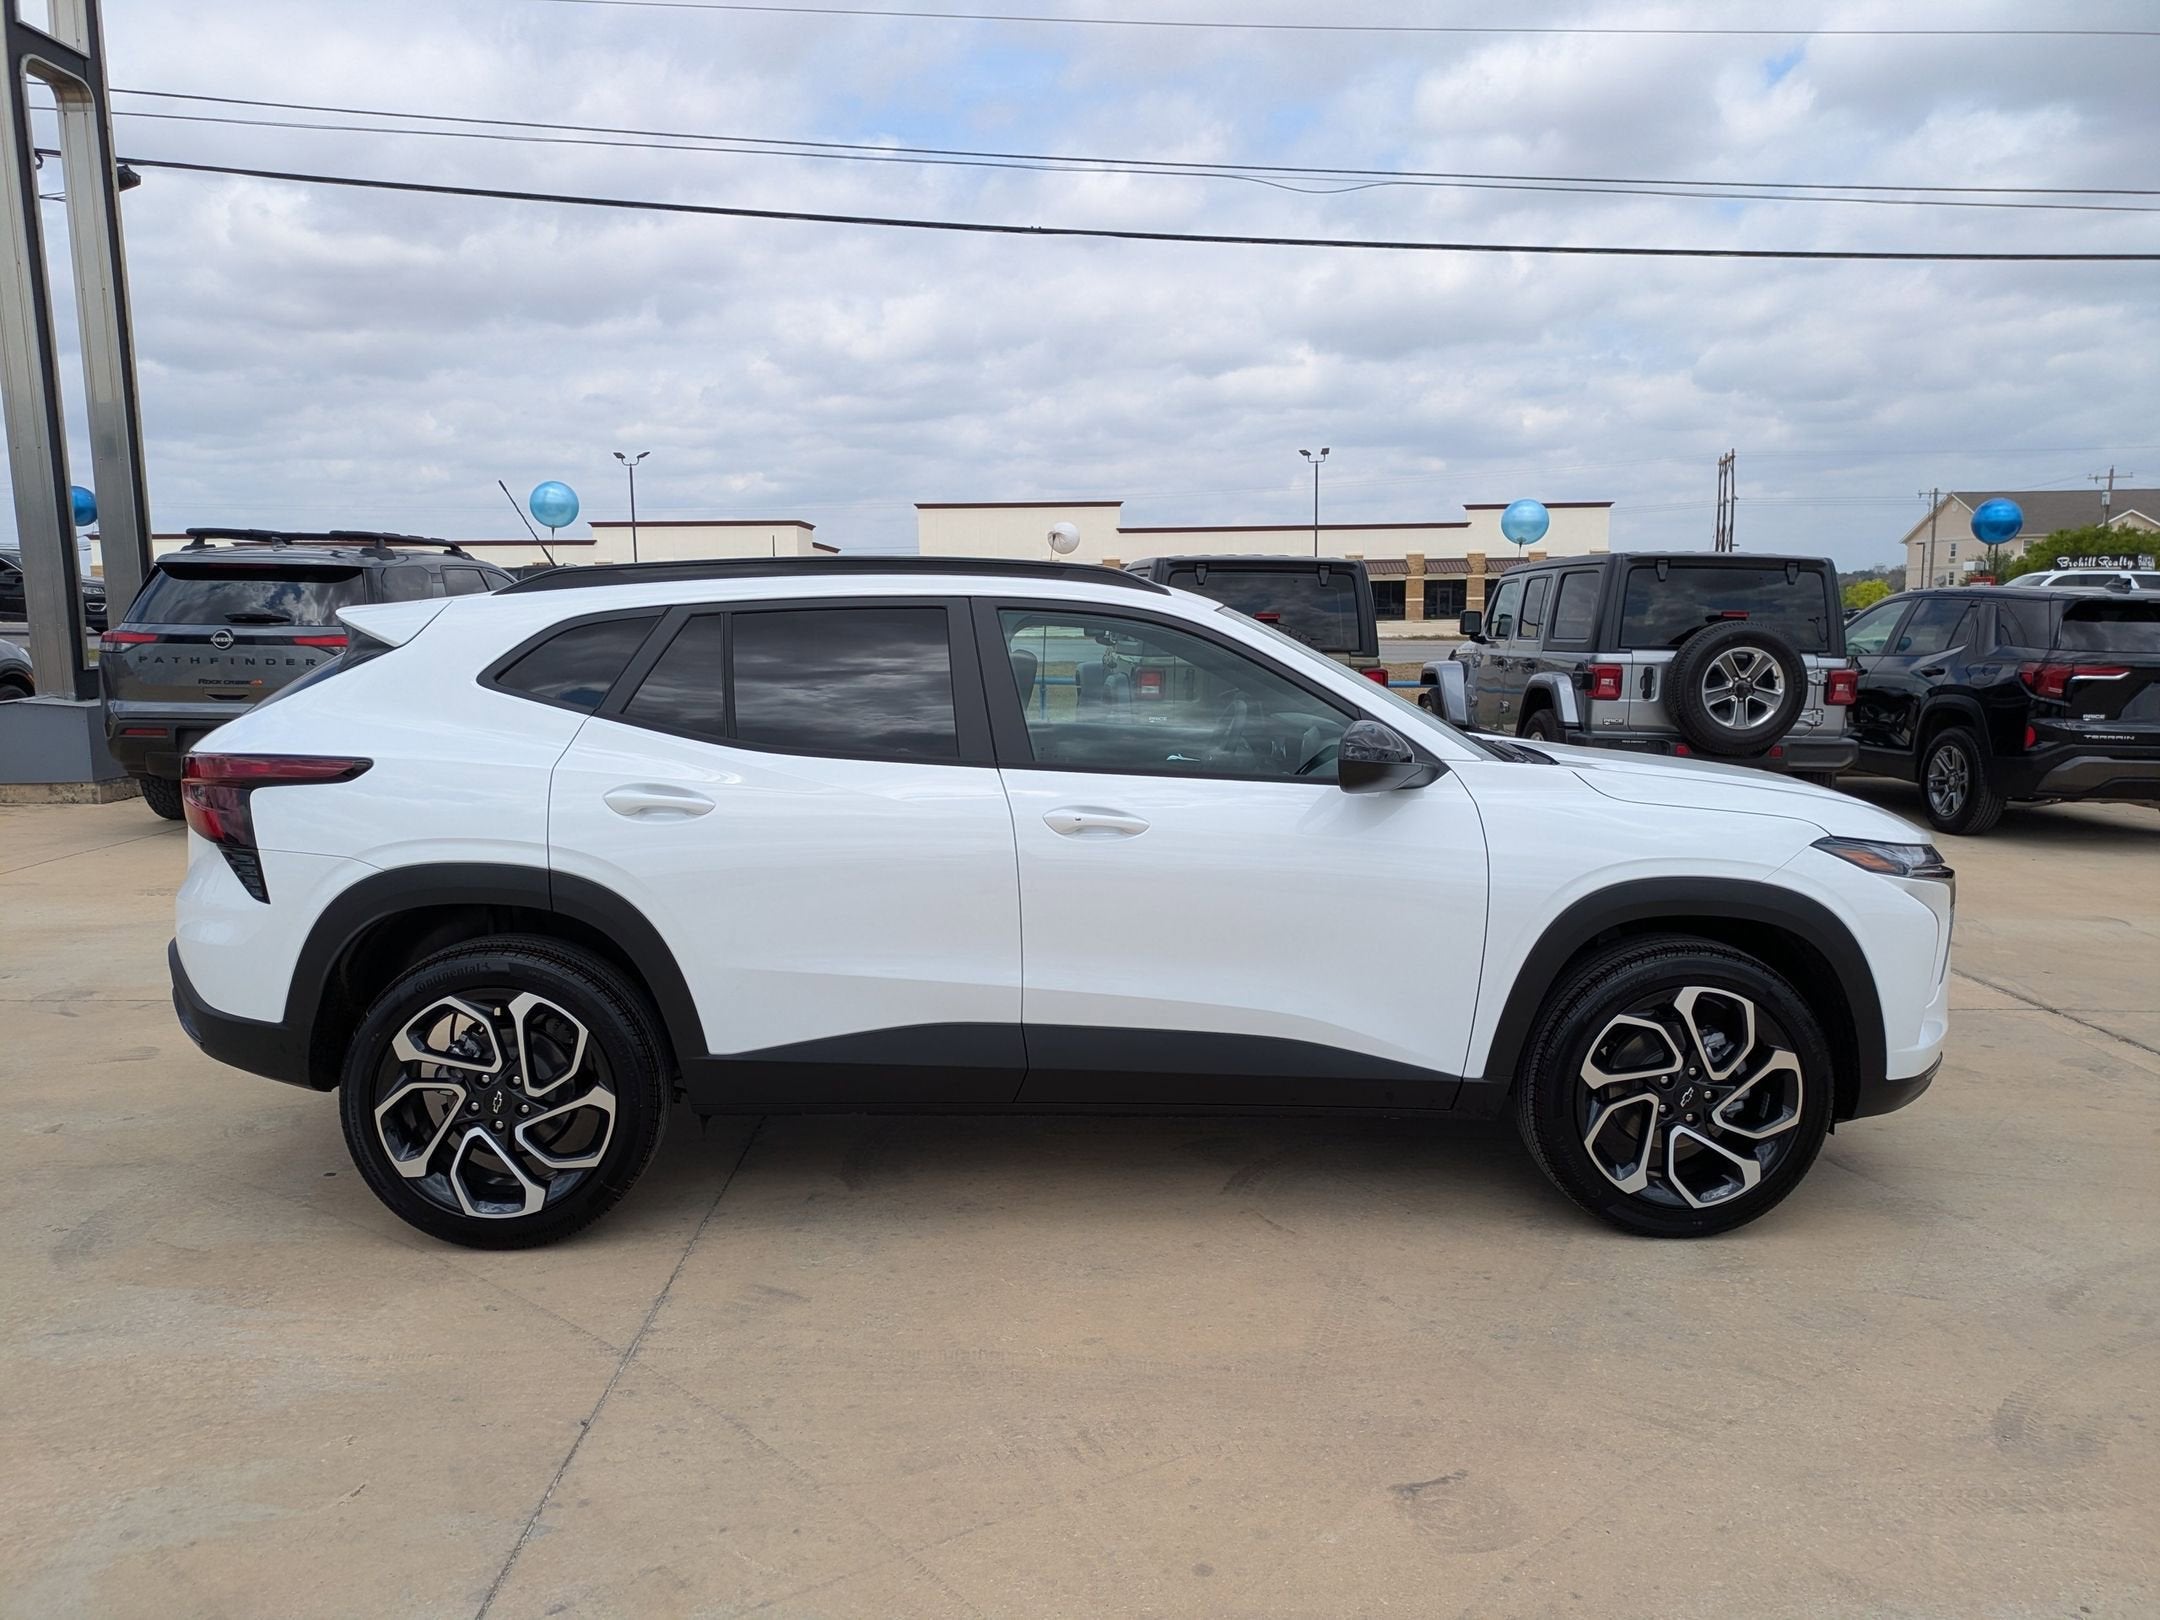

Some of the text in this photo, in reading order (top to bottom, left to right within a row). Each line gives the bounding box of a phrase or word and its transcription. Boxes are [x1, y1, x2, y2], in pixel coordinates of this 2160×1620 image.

[2098, 556, 2133, 569] Realty
[138, 656, 317, 666] PATHFINDER
[415, 962, 480, 993] Continental
